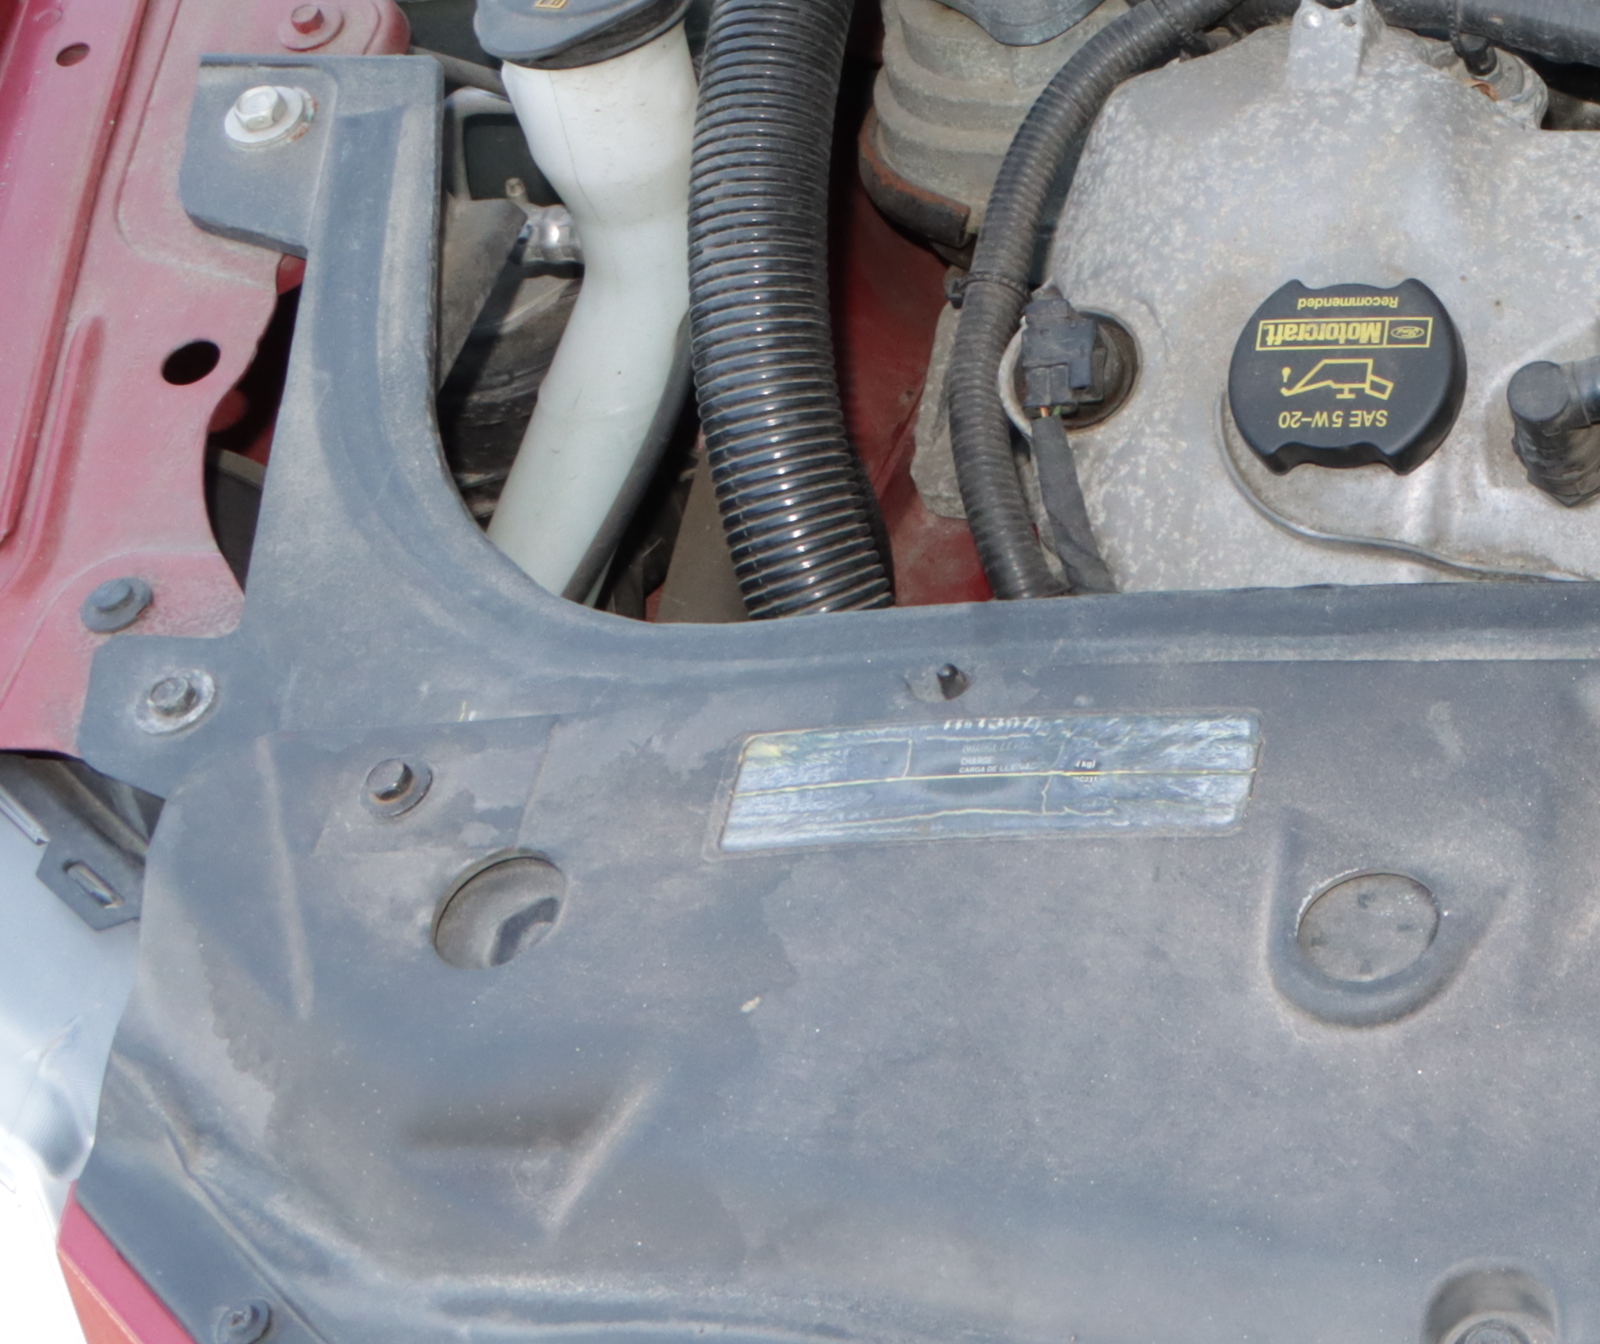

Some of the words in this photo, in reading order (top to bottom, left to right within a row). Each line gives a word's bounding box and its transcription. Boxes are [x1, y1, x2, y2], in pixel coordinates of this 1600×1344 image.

[1297, 296, 1399, 310] Recommended
[1265, 322, 1382, 346] Motorcraft
[1391, 326, 1424, 339] Ford
[1349, 410, 1388, 428] SAE
[959, 766, 985, 774] CARGA
[986, 765, 997, 773] DE
